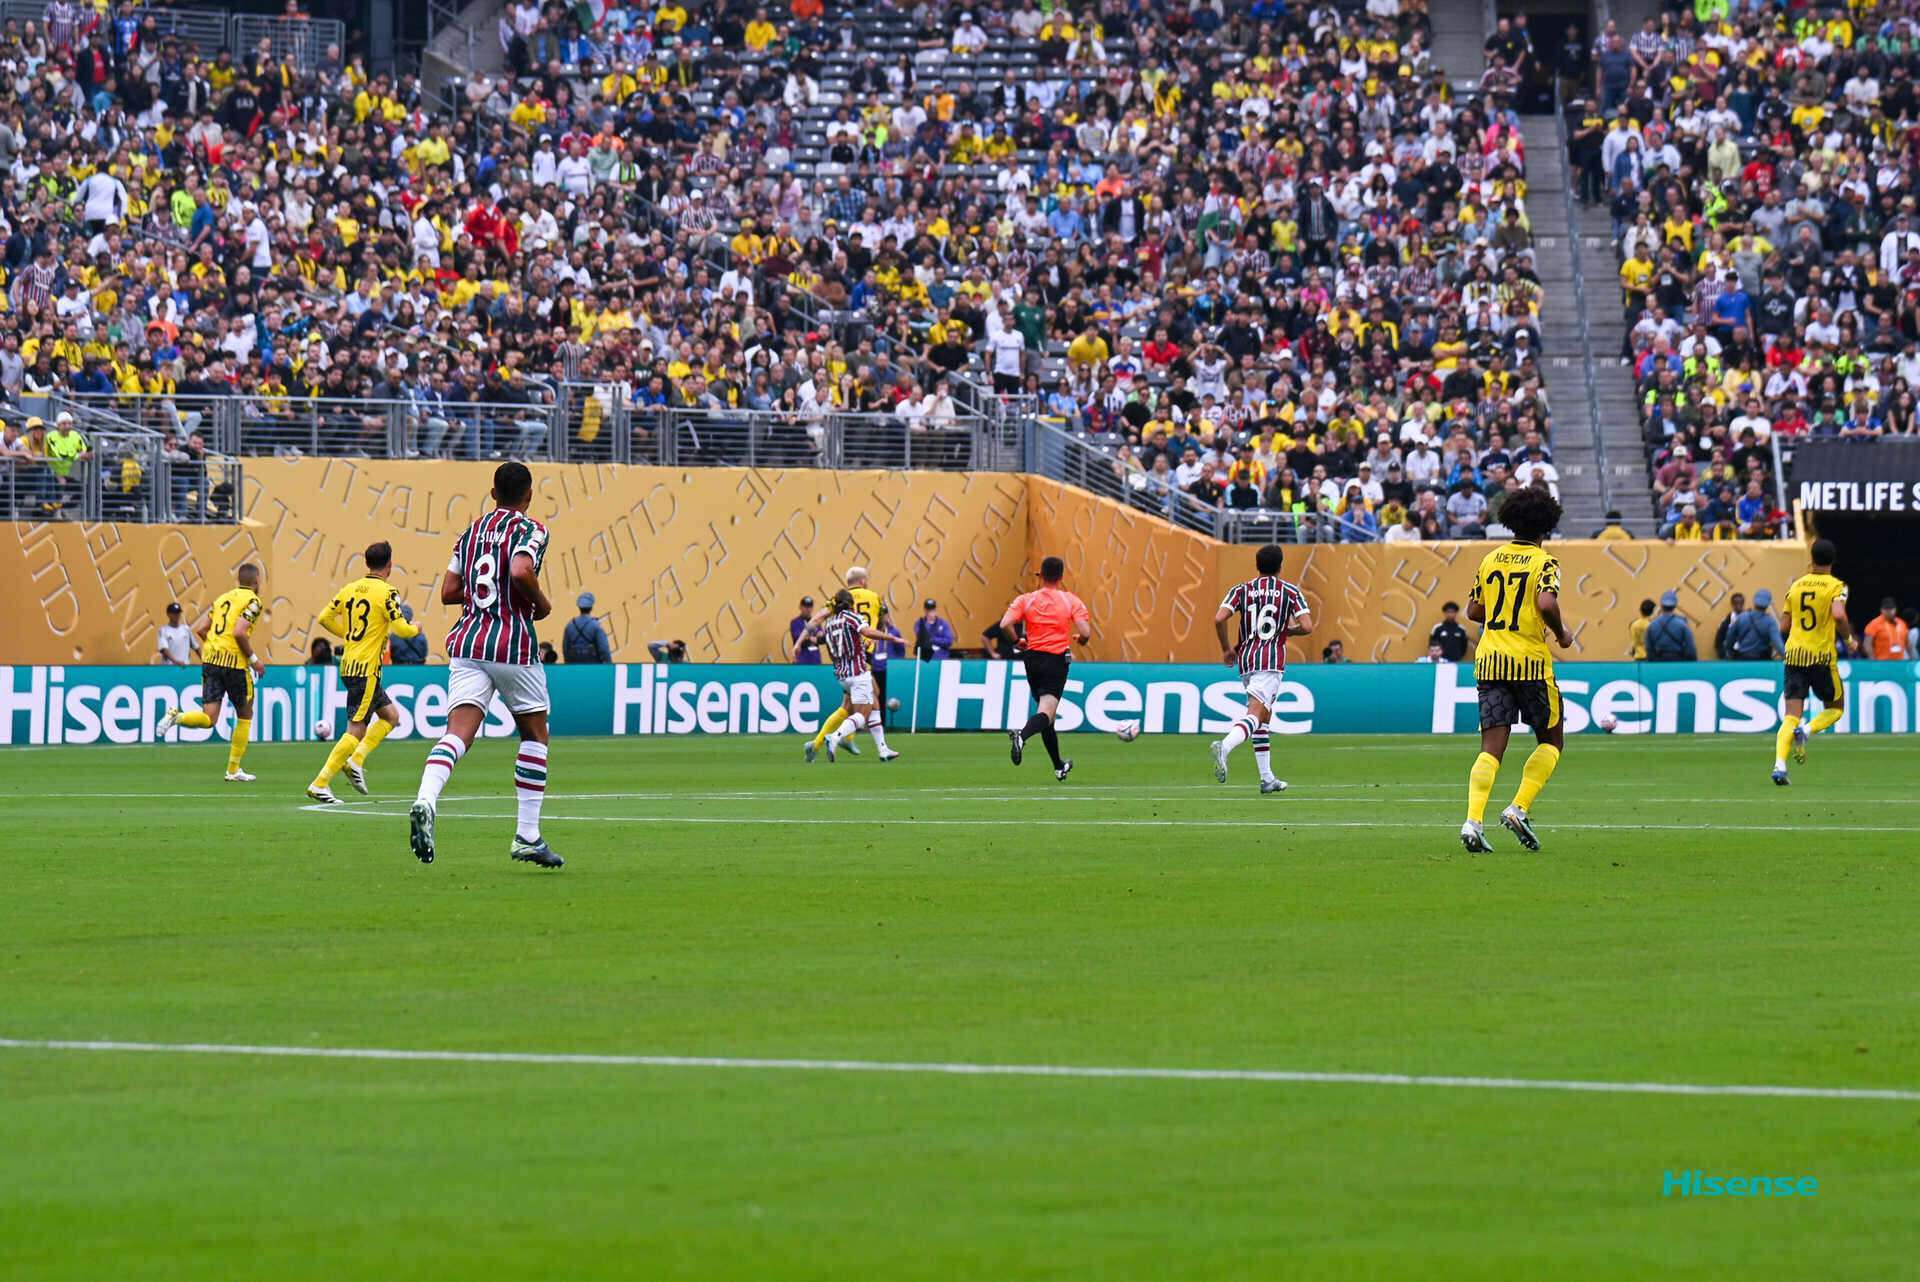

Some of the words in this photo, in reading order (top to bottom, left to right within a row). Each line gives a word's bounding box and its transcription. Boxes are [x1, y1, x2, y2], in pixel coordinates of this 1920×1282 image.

[1801, 482, 1905, 511] METLIFE
[1494, 552, 1532, 566] ADEYEMI
[472, 553, 497, 609] 3
[1486, 570, 1530, 632] 27
[214, 601, 231, 635] 3
[345, 596, 371, 642] 13
[1247, 603, 1278, 640] 16
[1800, 591, 1817, 632] 5
[613, 663, 820, 735] Hisense
